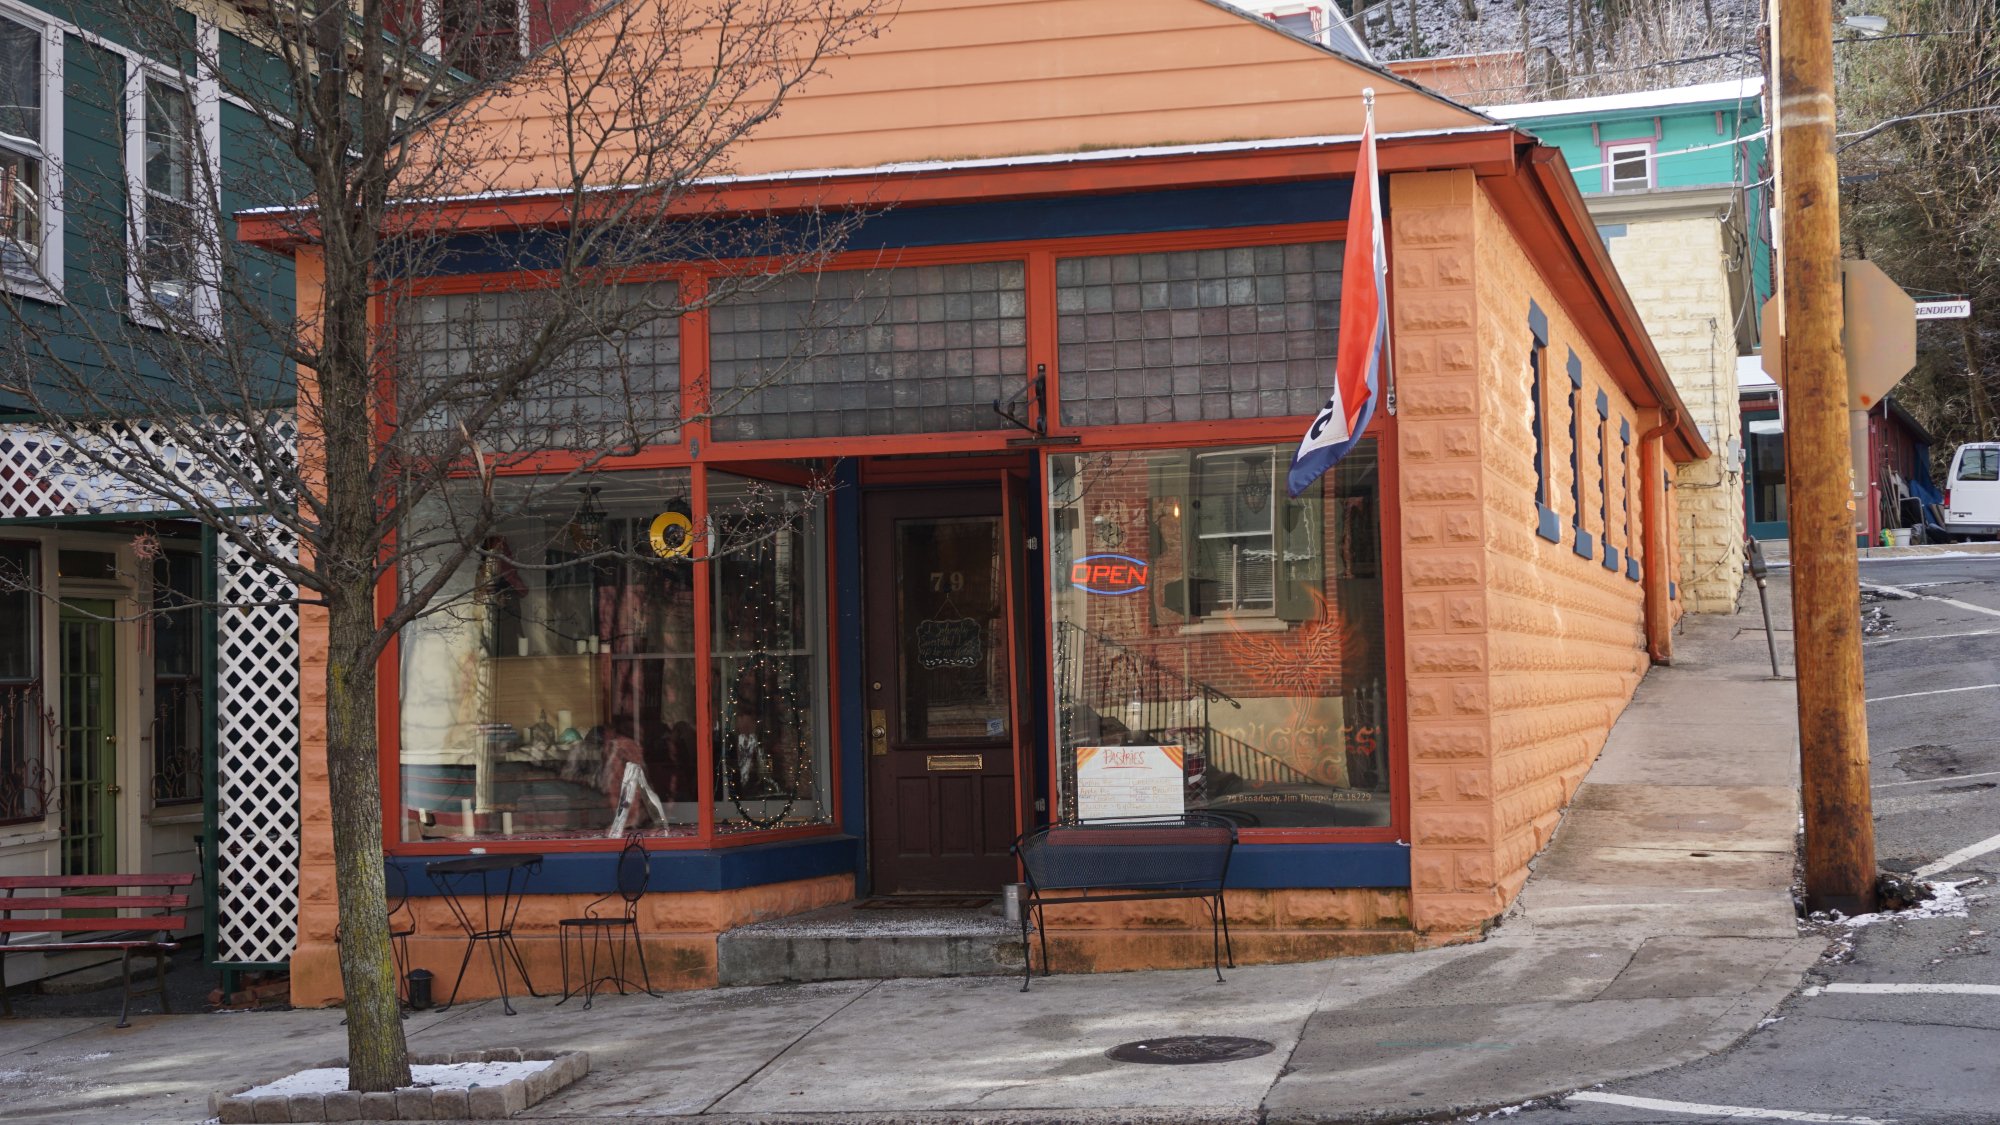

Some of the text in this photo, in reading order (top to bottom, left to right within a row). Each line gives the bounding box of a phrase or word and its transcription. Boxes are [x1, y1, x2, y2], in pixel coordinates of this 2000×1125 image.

[1915, 305, 1966, 315] RENDIPITY
[930, 572, 964, 592] 79
[1071, 564, 1148, 585] OPEN
[1284, 793, 1298, 802] Jim
